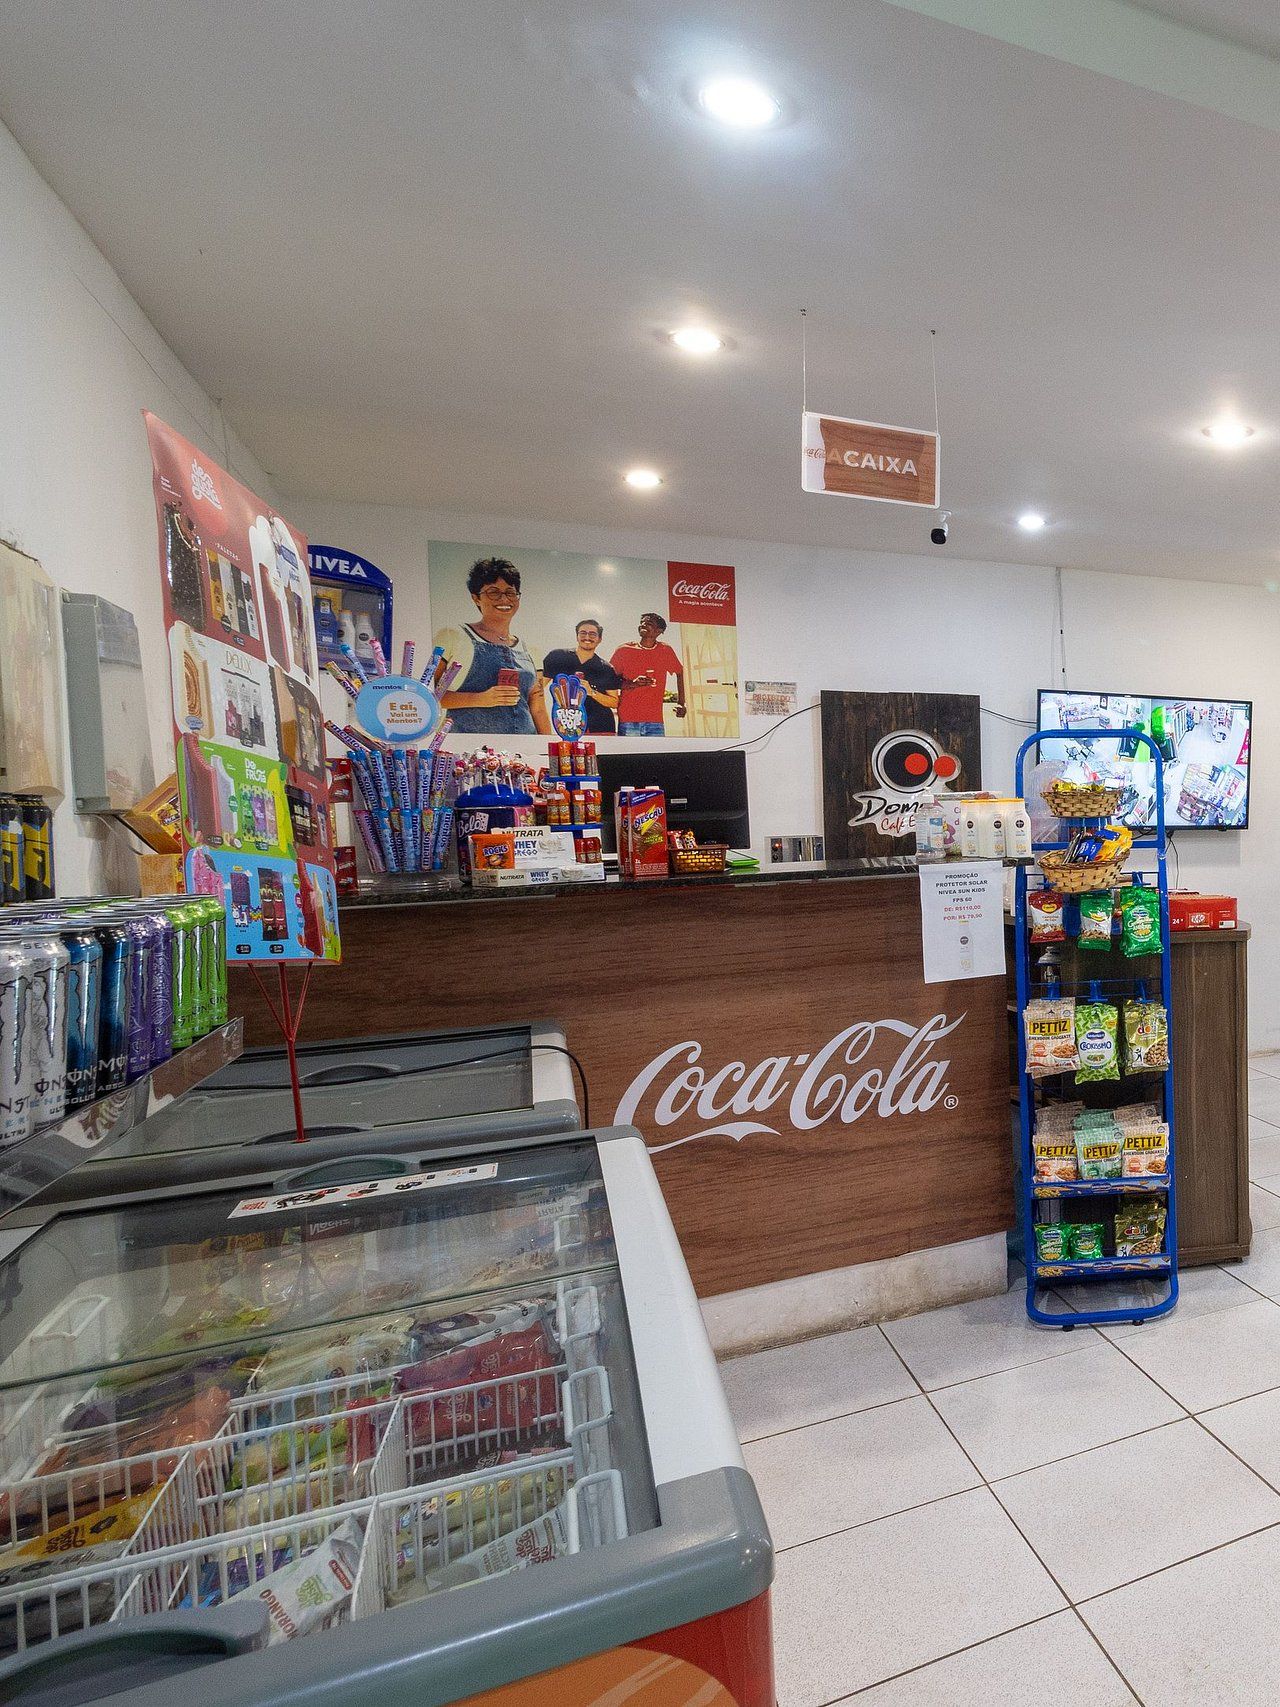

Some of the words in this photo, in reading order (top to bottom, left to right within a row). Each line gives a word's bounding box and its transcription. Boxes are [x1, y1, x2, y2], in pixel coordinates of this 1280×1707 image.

[843, 450, 918, 476] CAIXA
[672, 580, 731, 601] Coca-Cola
[389, 702, 396, 711] E
[331, 723, 366, 752] mentos
[633, 806, 664, 829] NESCAU
[881, 818, 906, 833] Café
[1032, 1020, 1069, 1034] PETTiZ
[614, 1011, 967, 1154] Coca-Cola
[1126, 1136, 1162, 1149] PETTiZ
[1039, 1145, 1075, 1157] PETTiZ
[1085, 1144, 1118, 1158] PETTiZ
